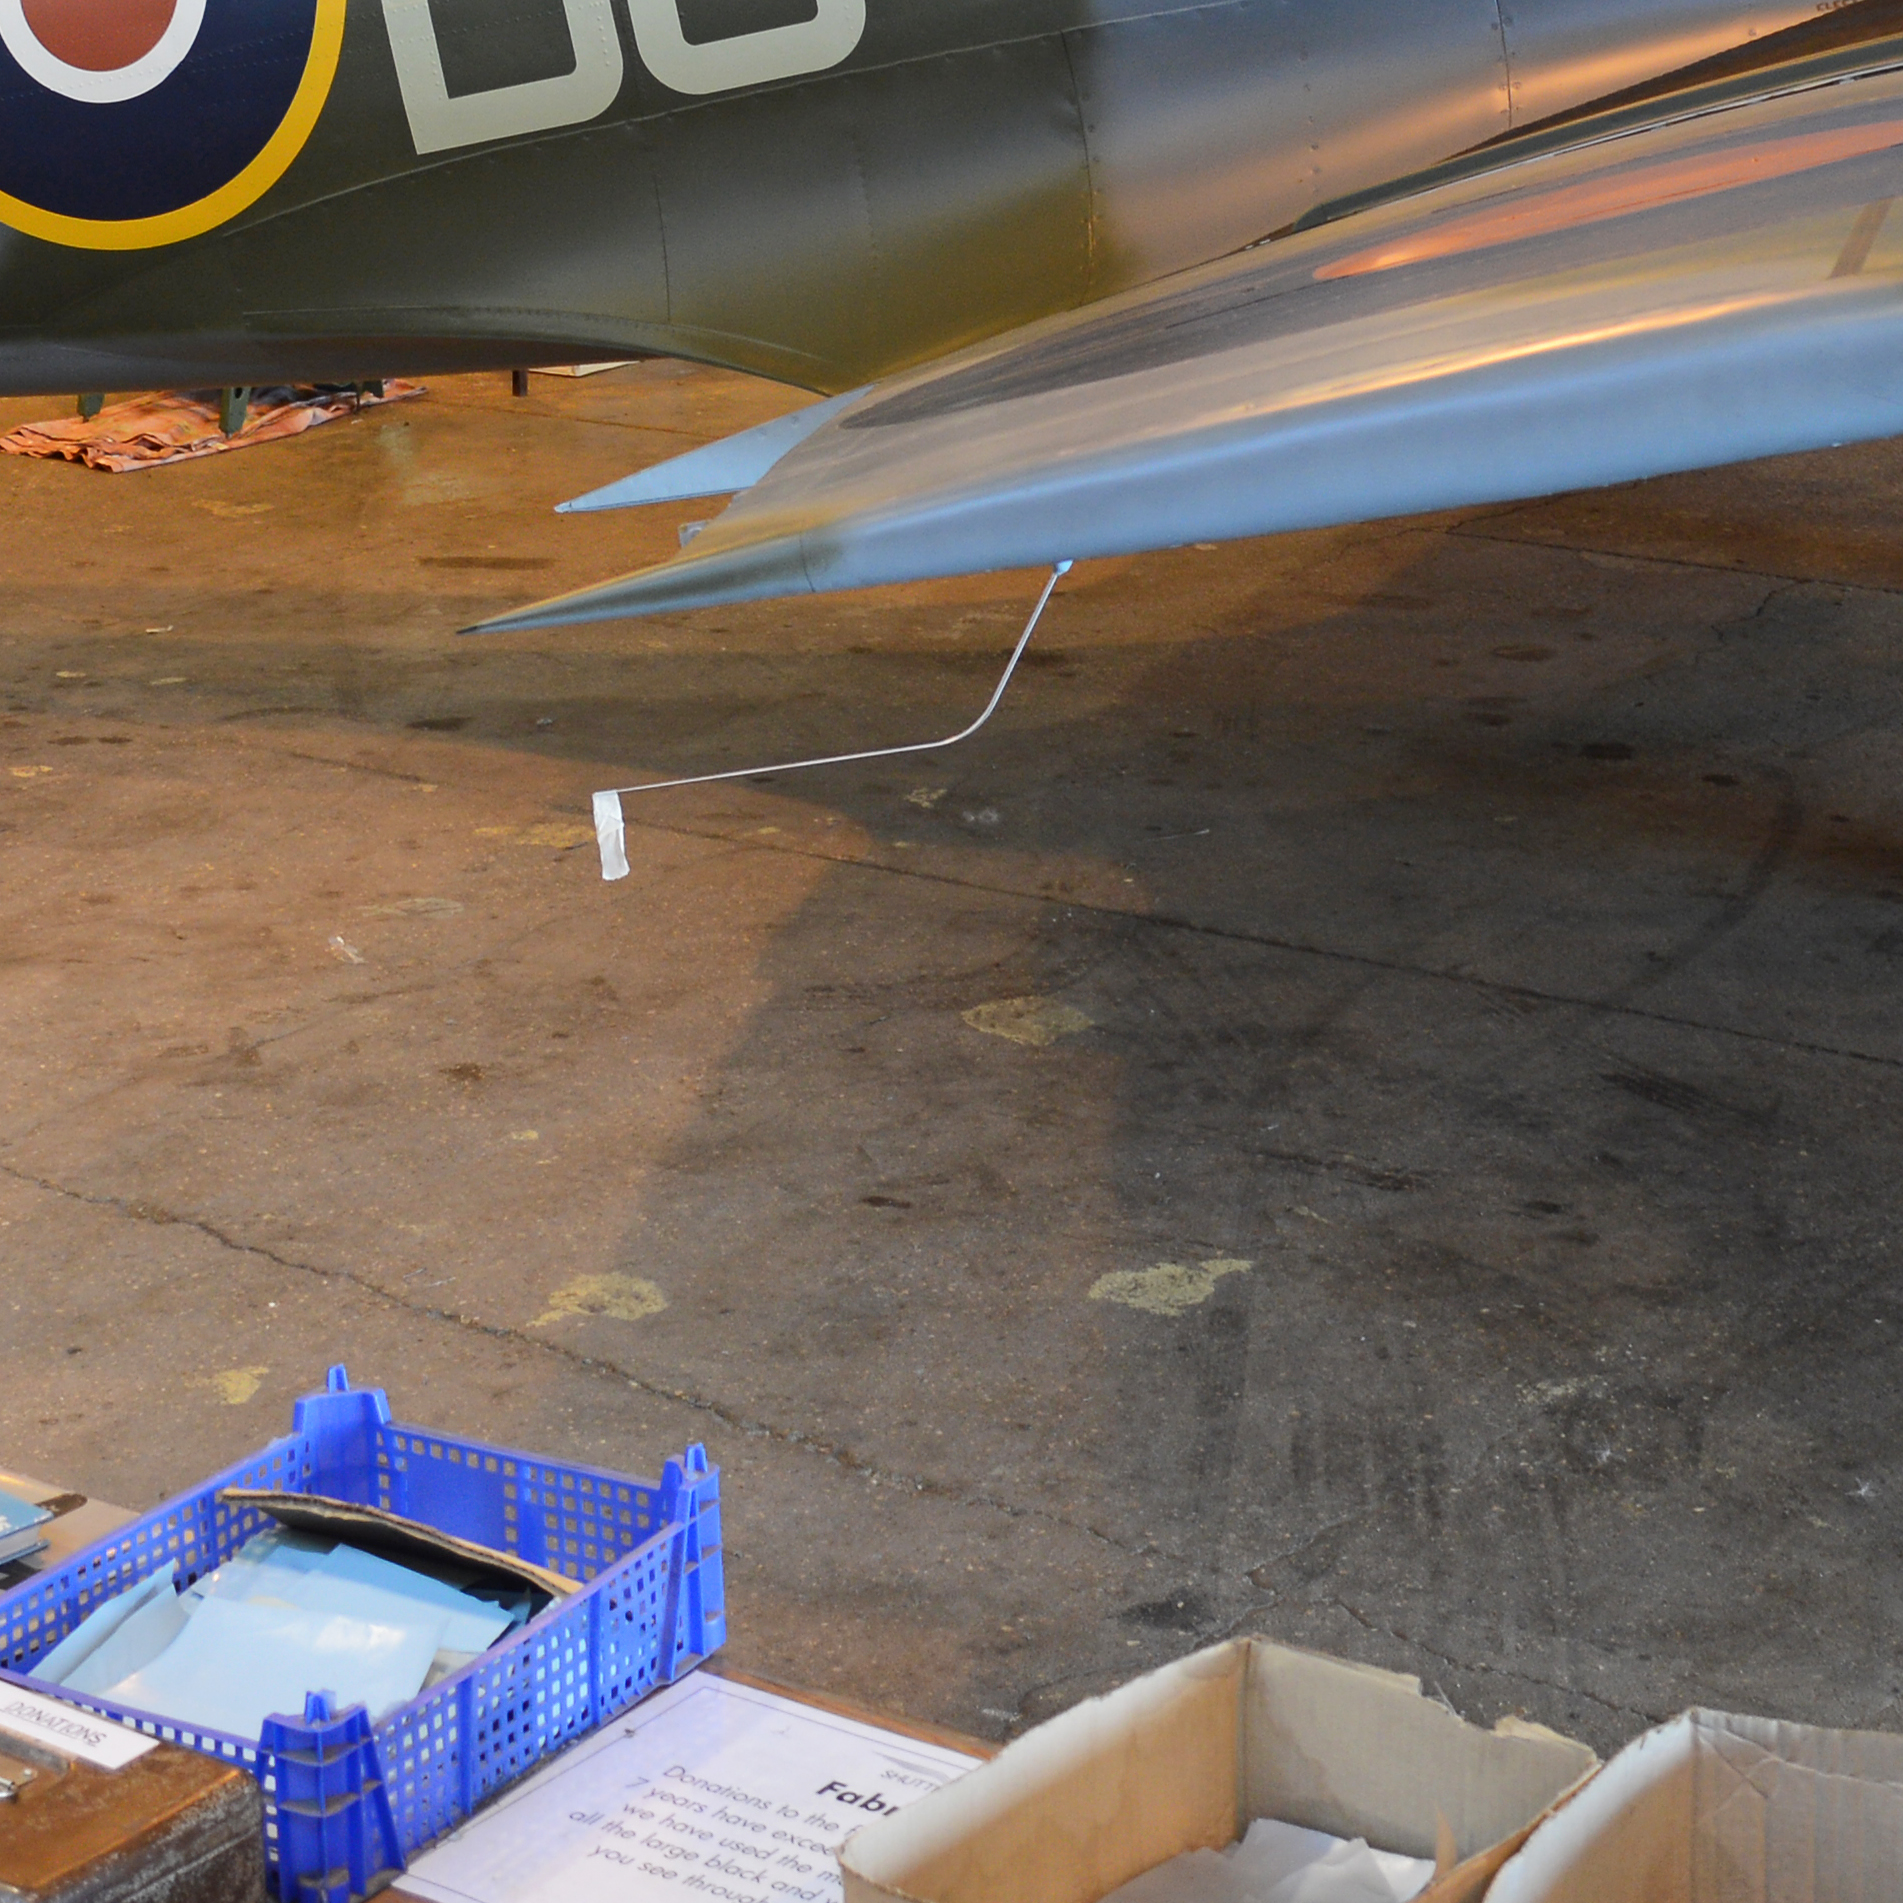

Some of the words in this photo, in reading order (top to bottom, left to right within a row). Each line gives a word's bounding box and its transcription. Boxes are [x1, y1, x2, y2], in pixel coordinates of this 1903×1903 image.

[1, 1700, 108, 1747] DONATIONS
[643, 1786, 706, 1814] years
[711, 1806, 769, 1834] have
[662, 1764, 773, 1811] Donations
[778, 1804, 800, 1819] to
[804, 1812, 840, 1833] the
[569, 1809, 606, 1827] all
[600, 1818, 637, 1840] the
[641, 1833, 699, 1863] large
[704, 1853, 770, 1884] black
[770, 1878, 825, 1903] and
[587, 1843, 635, 1866] you
[637, 1861, 679, 1881] see
[622, 1802, 656, 1821] we
[659, 1814, 715, 1842] have
[718, 1836, 779, 1862] used
[777, 1853, 813, 1875] the
